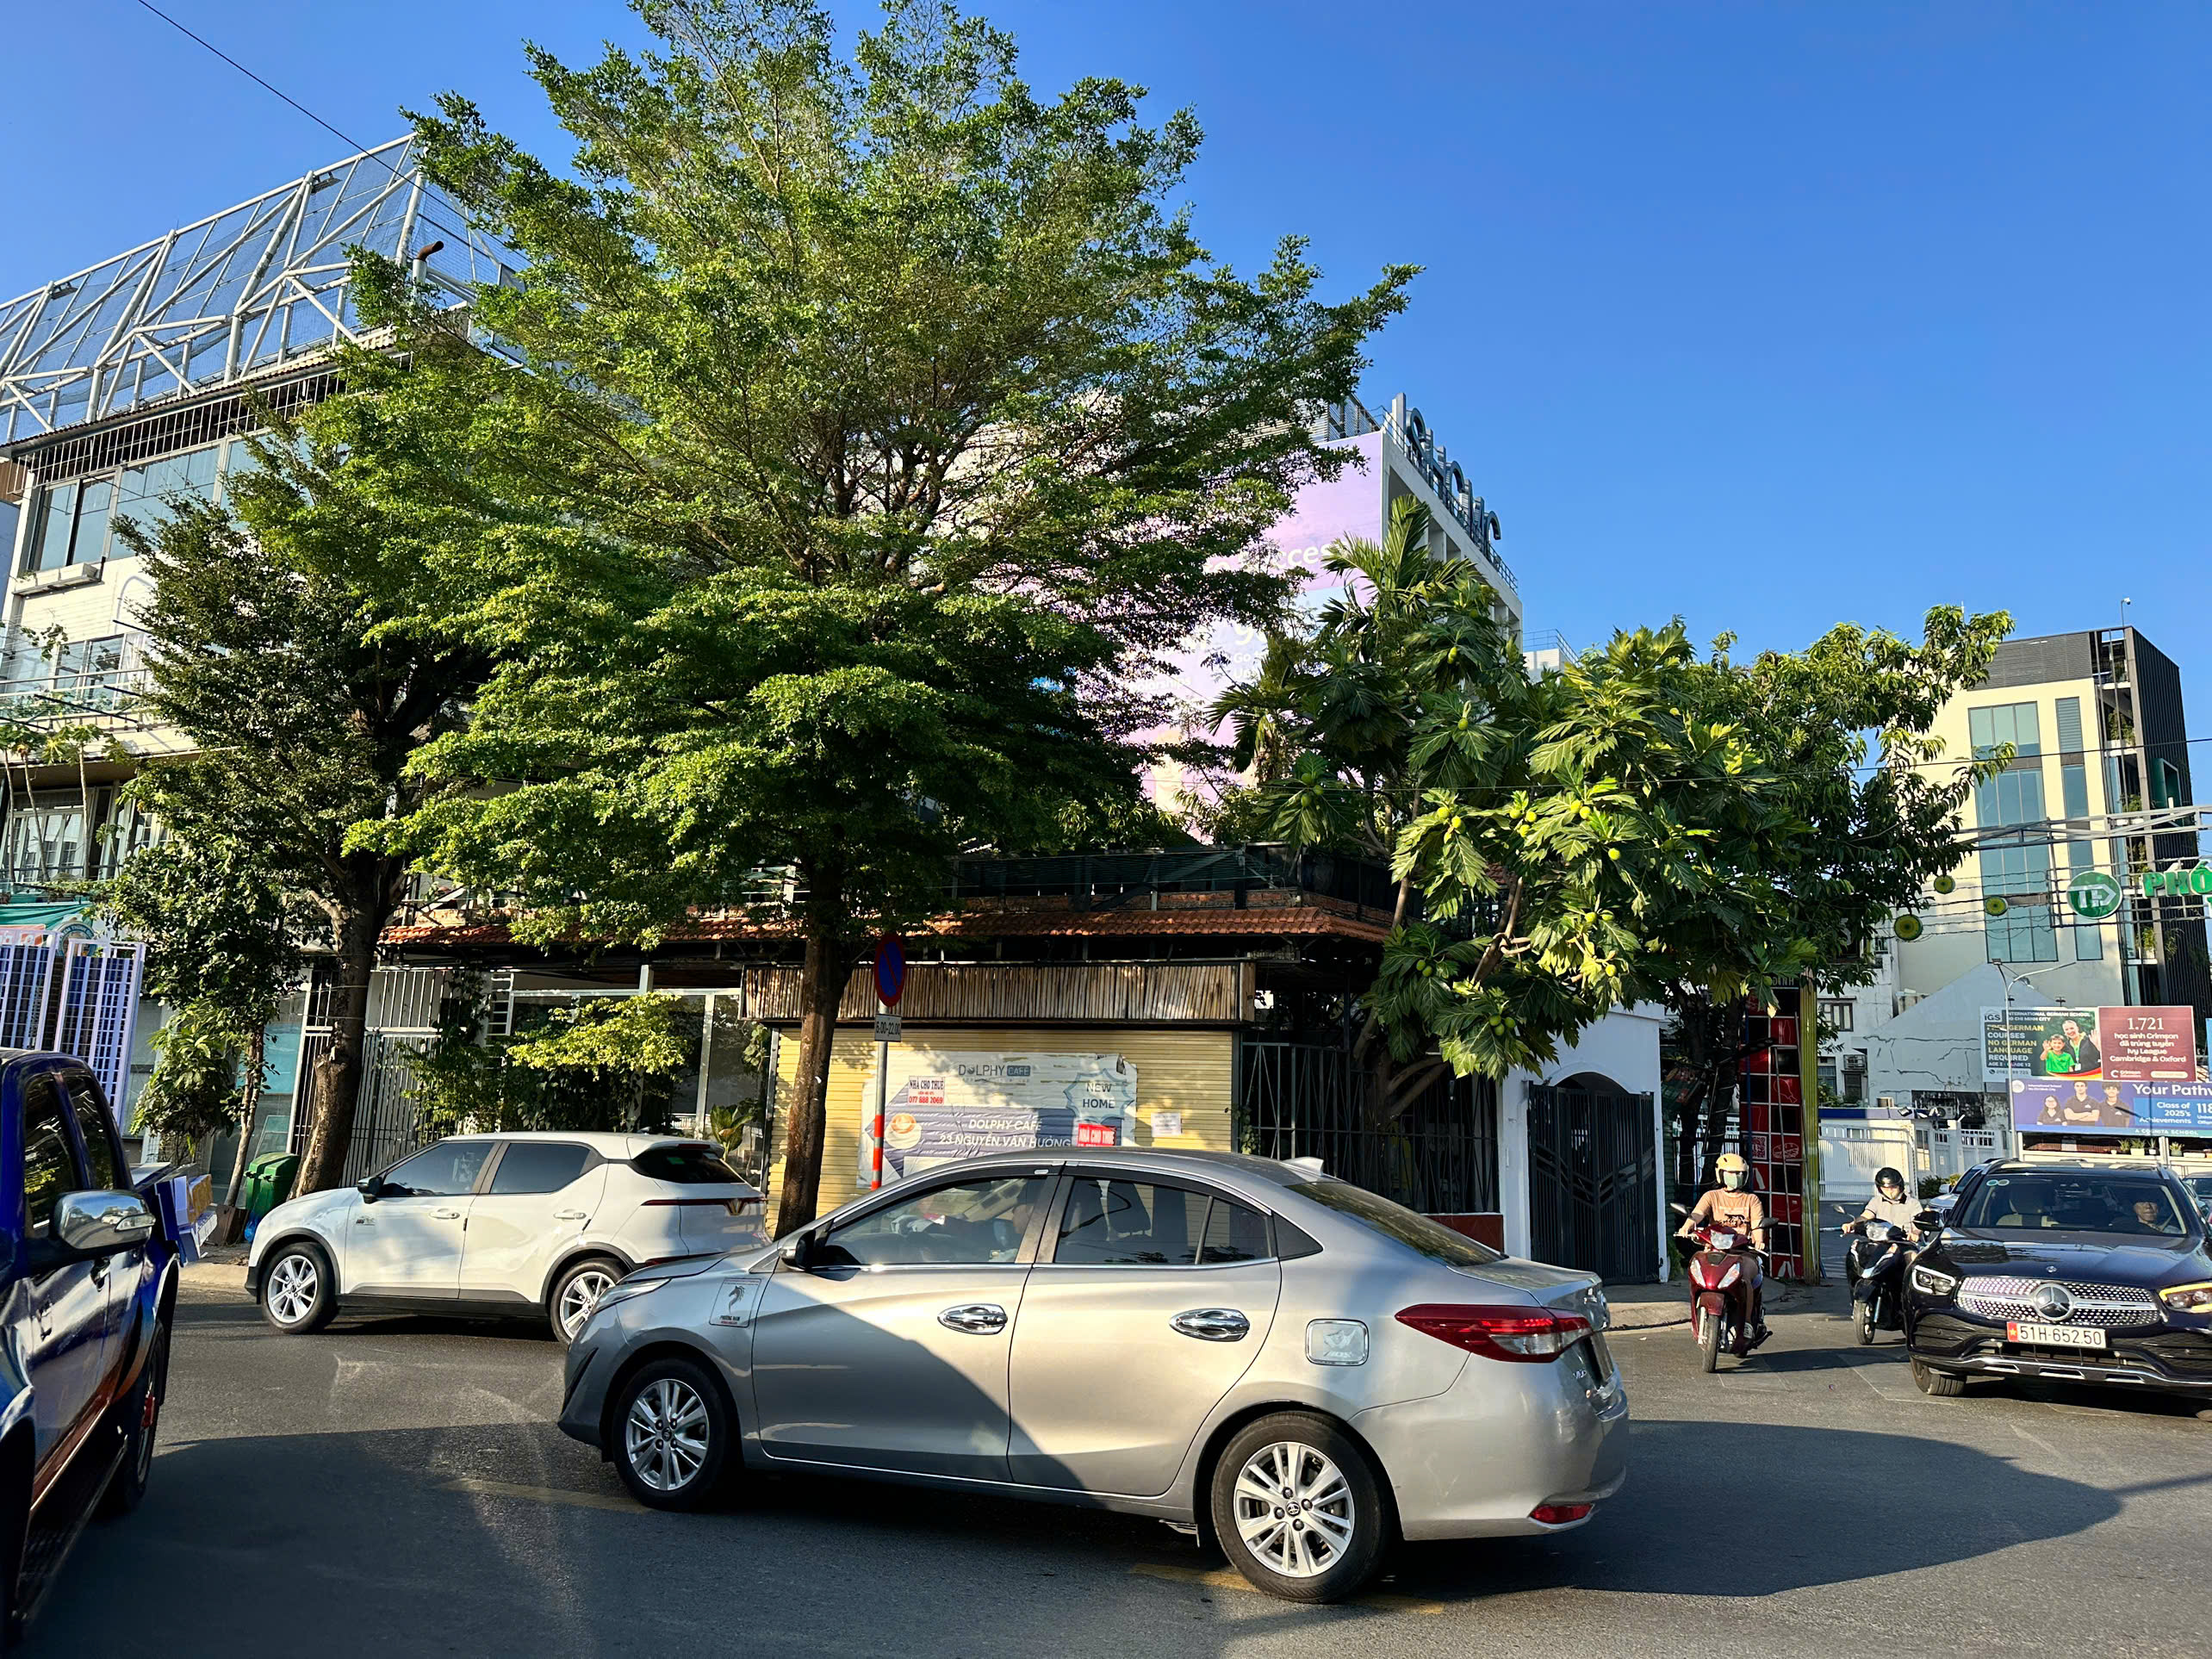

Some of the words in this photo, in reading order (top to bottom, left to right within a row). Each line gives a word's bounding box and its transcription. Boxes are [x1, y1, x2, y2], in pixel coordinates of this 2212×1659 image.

[2127, 1017, 2165, 1030] 1.721
[1086, 1083, 1112, 1092] NEW
[2132, 1084, 2169, 1095] Your
[1082, 1098, 1115, 1109] HOME
[968, 1119, 1011, 1130] DOLPHY
[2020, 1326, 2103, 1345] 51H-652.50
